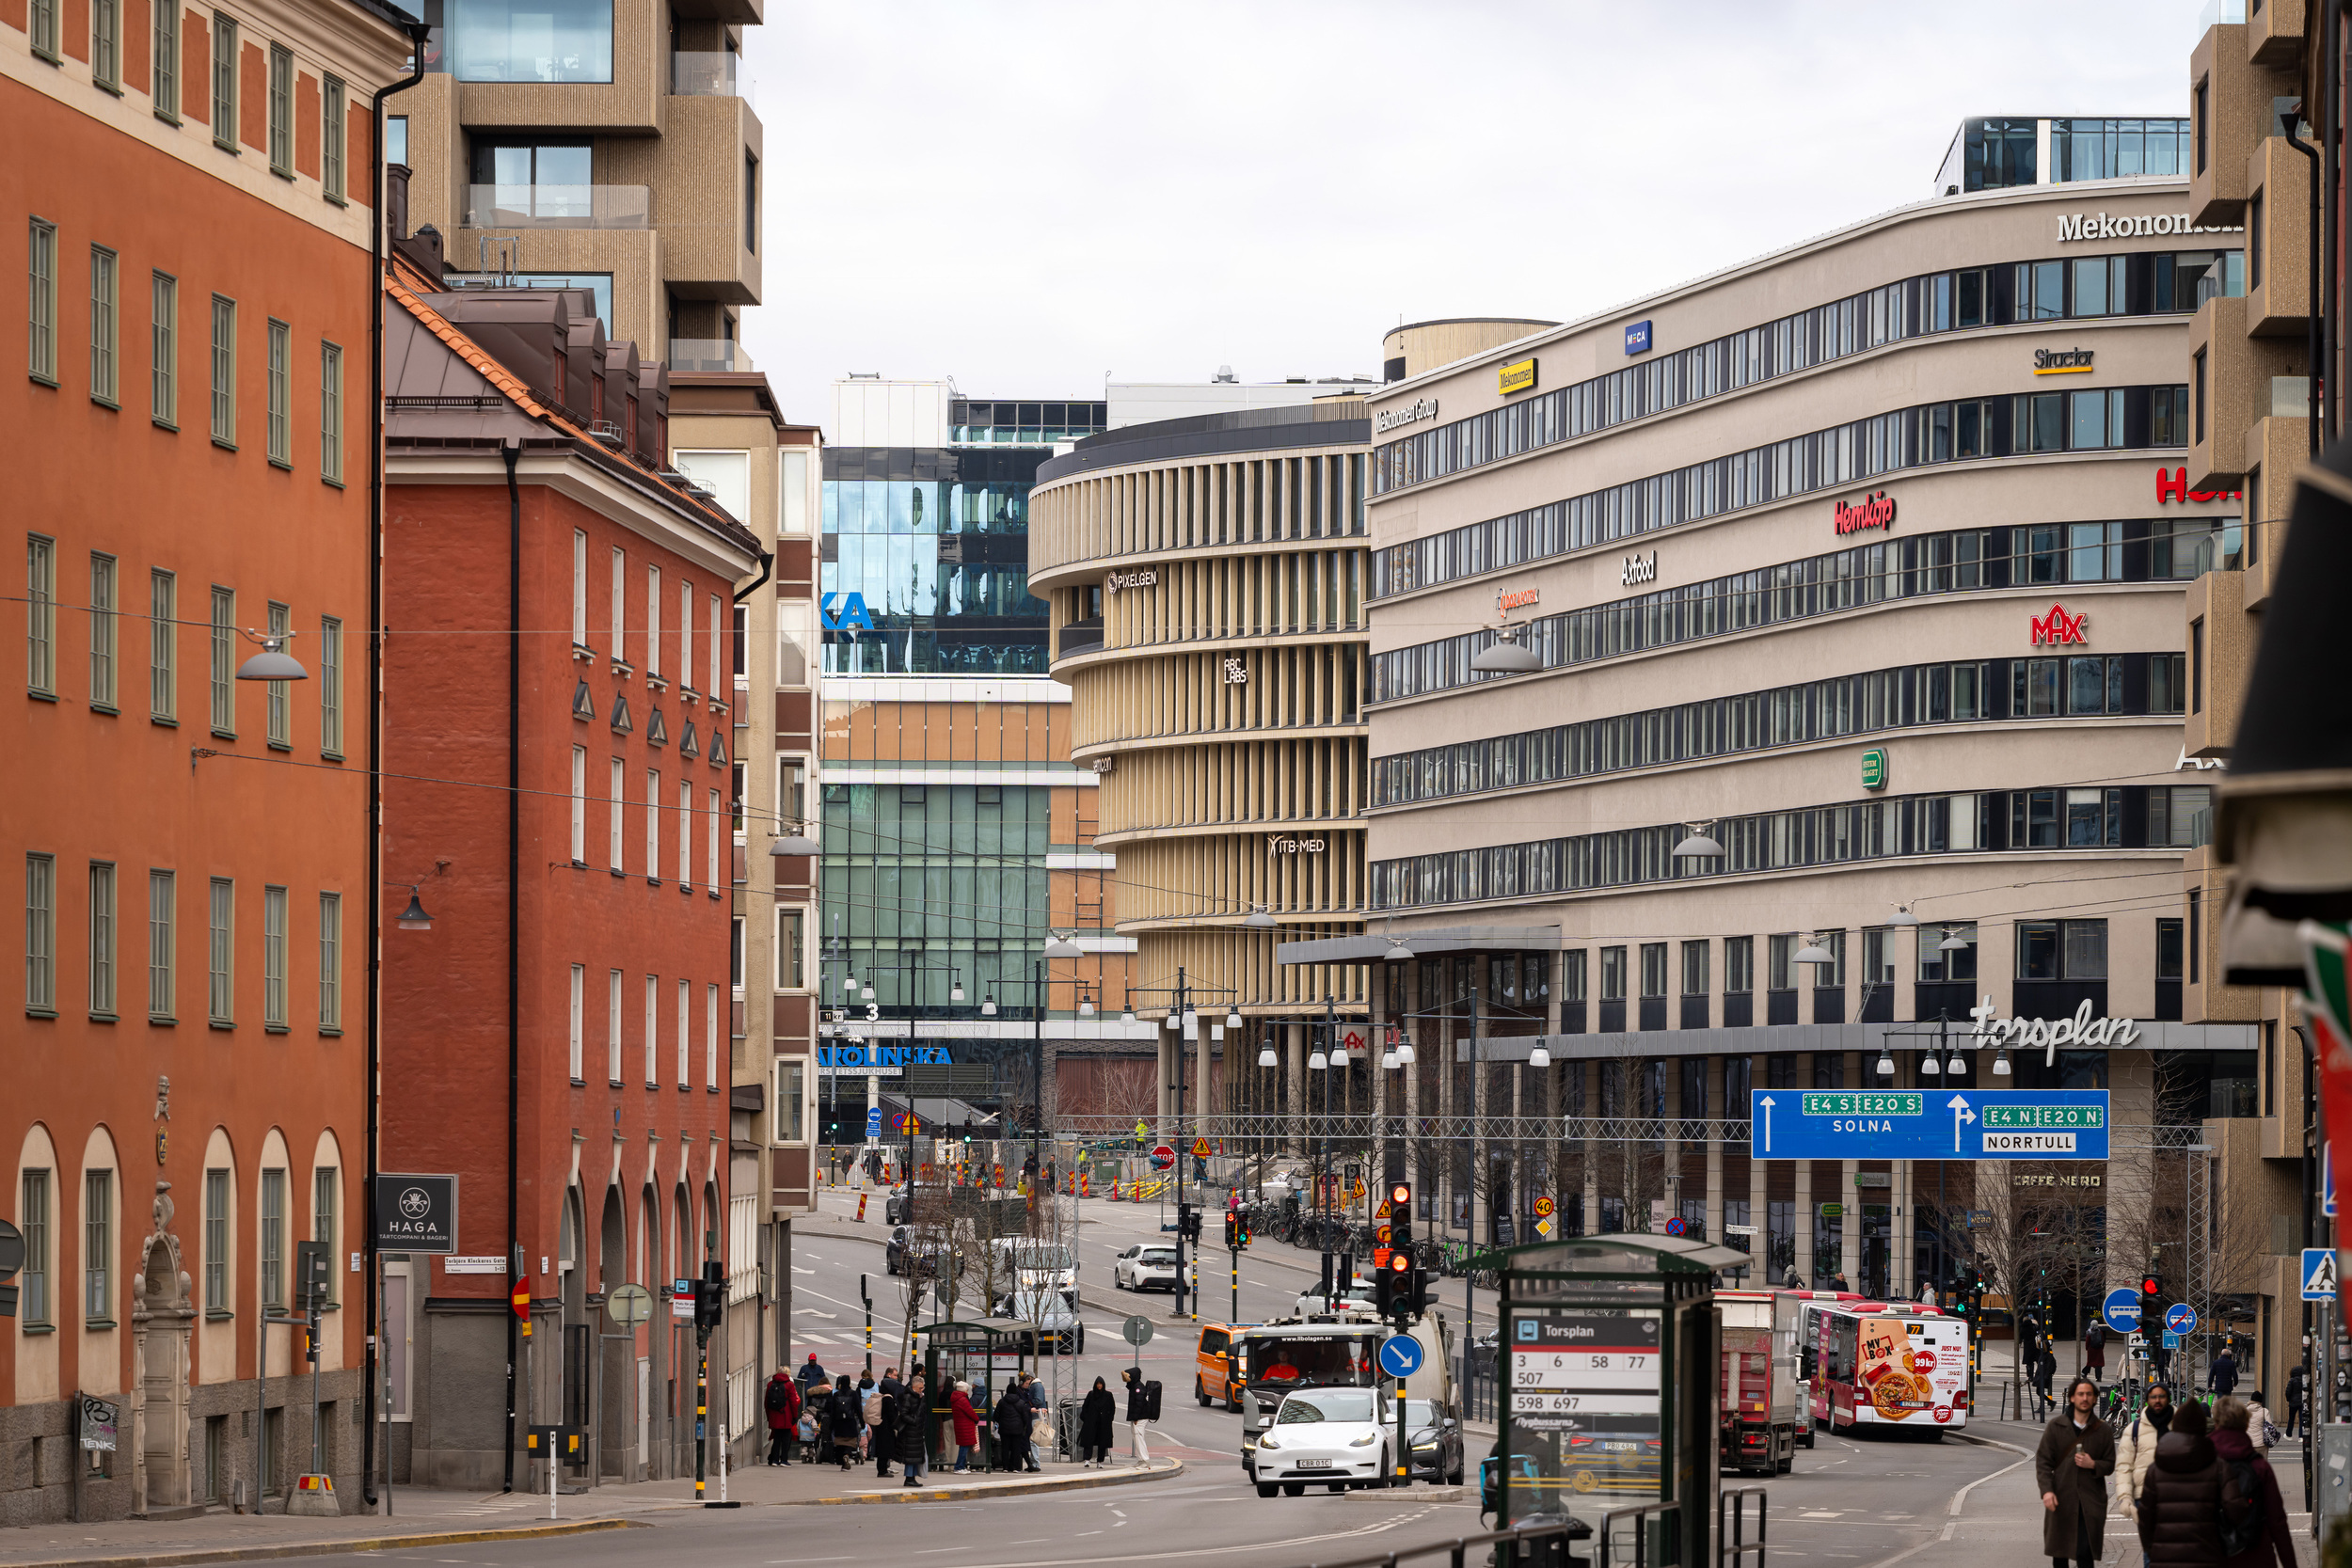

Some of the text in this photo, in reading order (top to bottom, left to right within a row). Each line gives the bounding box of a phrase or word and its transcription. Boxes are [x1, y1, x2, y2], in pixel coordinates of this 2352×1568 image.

[2033, 346, 2094, 369] Structor
[1500, 367, 1532, 389] Mekonomen
[1375, 396, 1438, 435] Mekonomen Group
[1834, 490, 1895, 535] Hemköp
[1620, 549, 1656, 586] Axfood
[1118, 570, 1157, 589] PIXELGEN
[2030, 601, 2089, 646] MAX
[1224, 657, 1241, 671] ABC
[1224, 670, 1248, 684] LABS
[1279, 839, 1325, 853] ITB-MED
[865, 1003, 879, 1022] 3
[1969, 994, 2140, 1068] torsplan
[1811, 1098, 1850, 1111] E4 S
[1864, 1098, 1916, 1111] E20 S
[1991, 1110, 2030, 1123] E4 N
[2043, 1110, 2097, 1123] E20 N
[1833, 1119, 1893, 1132] SOLNA
[1988, 1136, 2073, 1149] NORRTULL
[1154, 1153, 1174, 1163] TOP
[2059, 1176, 2102, 1187] NERO
[1536, 1201, 1551, 1212] 40
[389, 1221, 437, 1233] HAGA
[1544, 1324, 1595, 1339] Torsplan
[1911, 1325, 1920, 1335] 77
[1866, 1338, 1881, 1352] MY
[1518, 1354, 1526, 1368] 3
[1553, 1354, 1563, 1368] 6
[1591, 1355, 1609, 1369] 58
[1628, 1356, 1645, 1369] 77
[1518, 1372, 1543, 1385] 507
[1518, 1397, 1543, 1409] 598
[1553, 1397, 1580, 1409] 697
[1516, 1417, 1574, 1429] Flygbussarna
